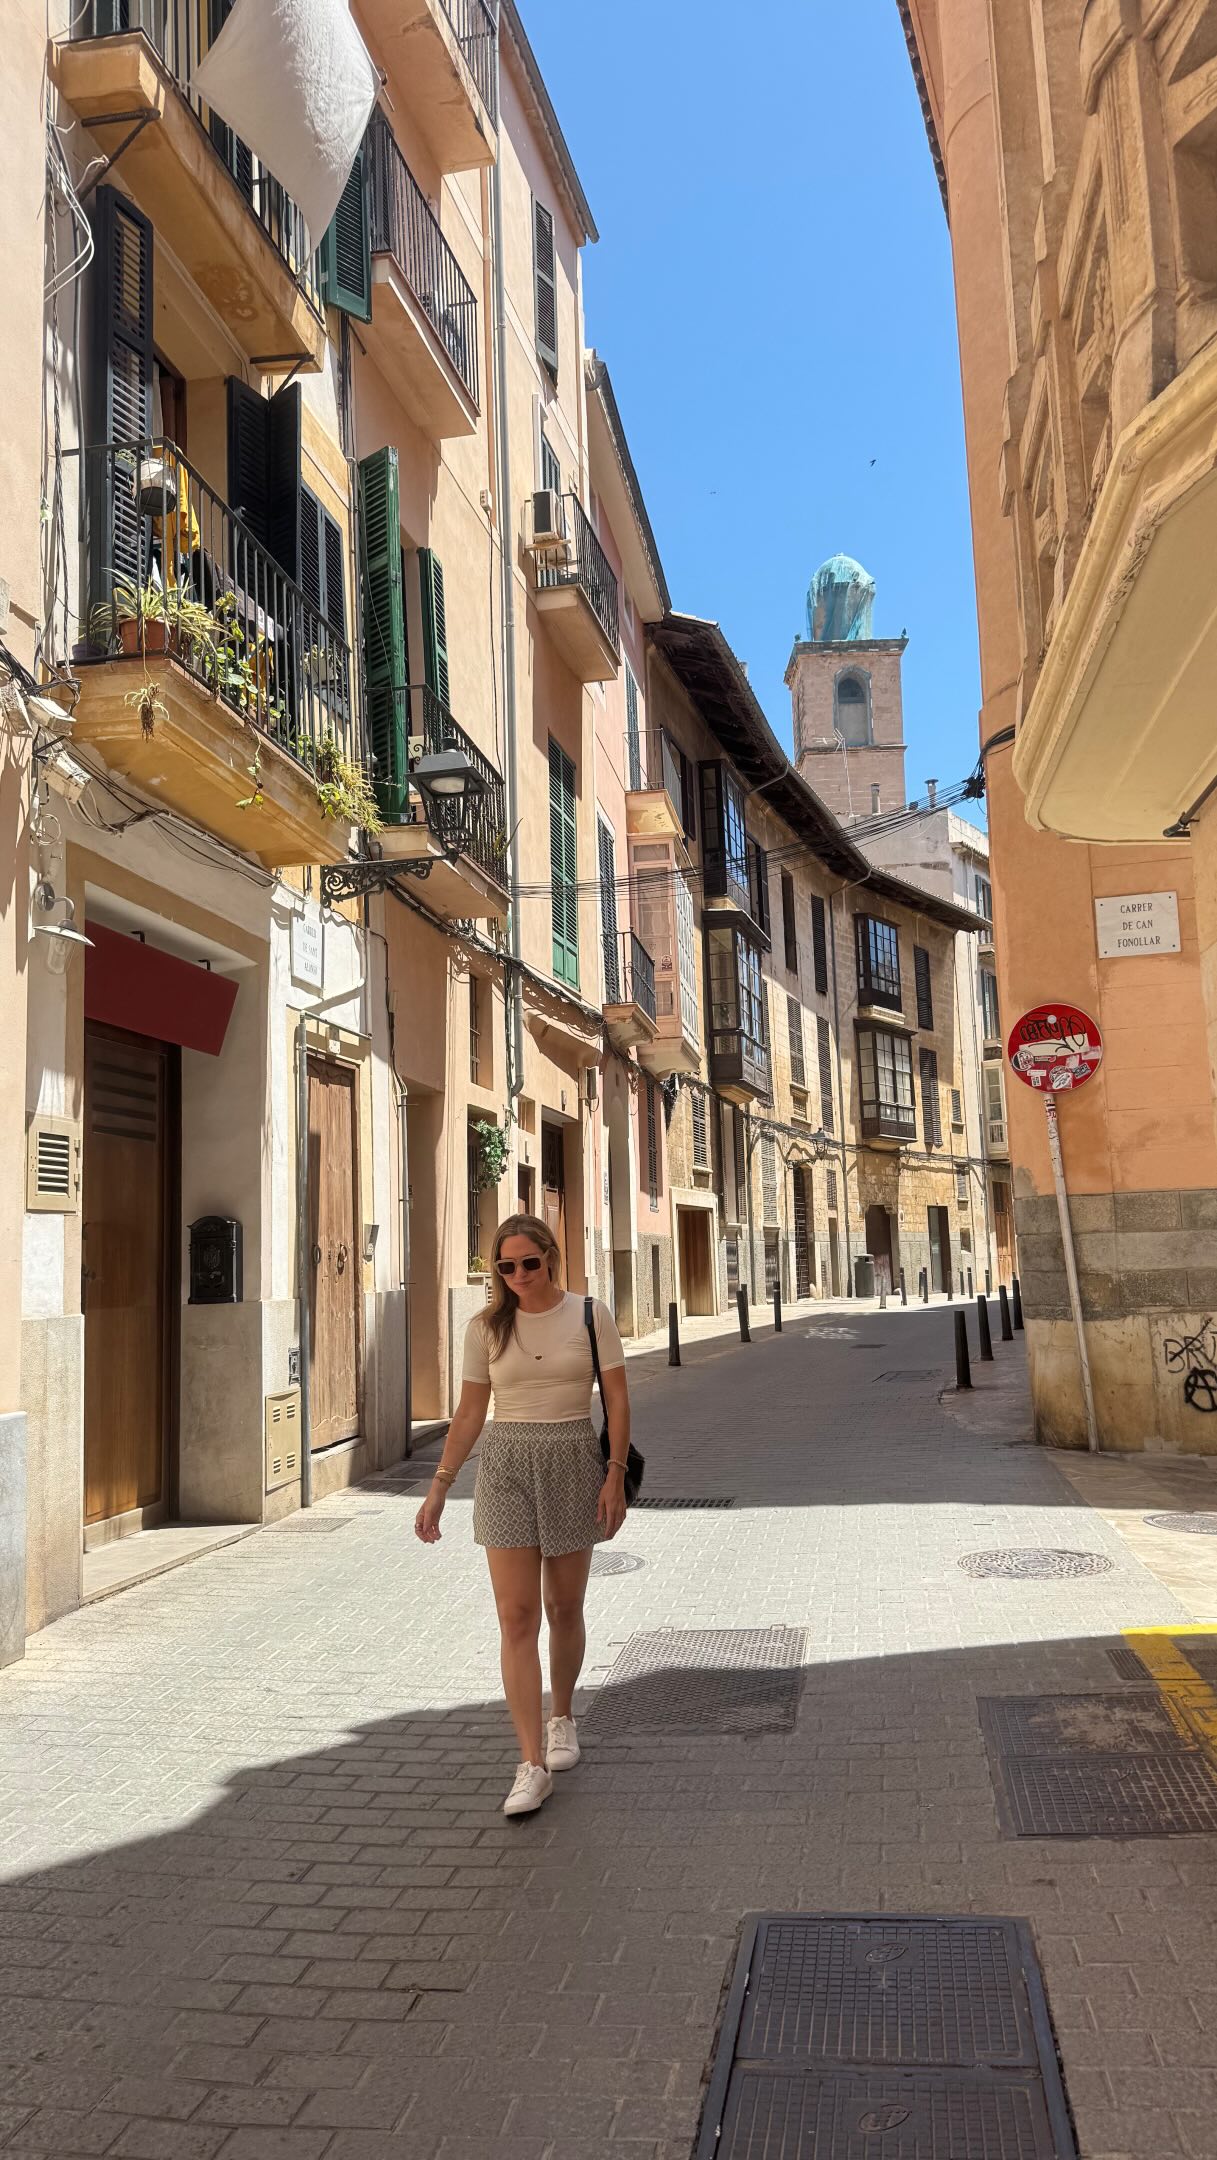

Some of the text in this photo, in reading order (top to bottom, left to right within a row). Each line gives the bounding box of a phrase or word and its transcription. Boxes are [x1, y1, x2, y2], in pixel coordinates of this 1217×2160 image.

[1120, 902, 1153, 914] CARRER
[1122, 919, 1153, 931] DE CAN
[1117, 935, 1161, 948] FONOLLAR
